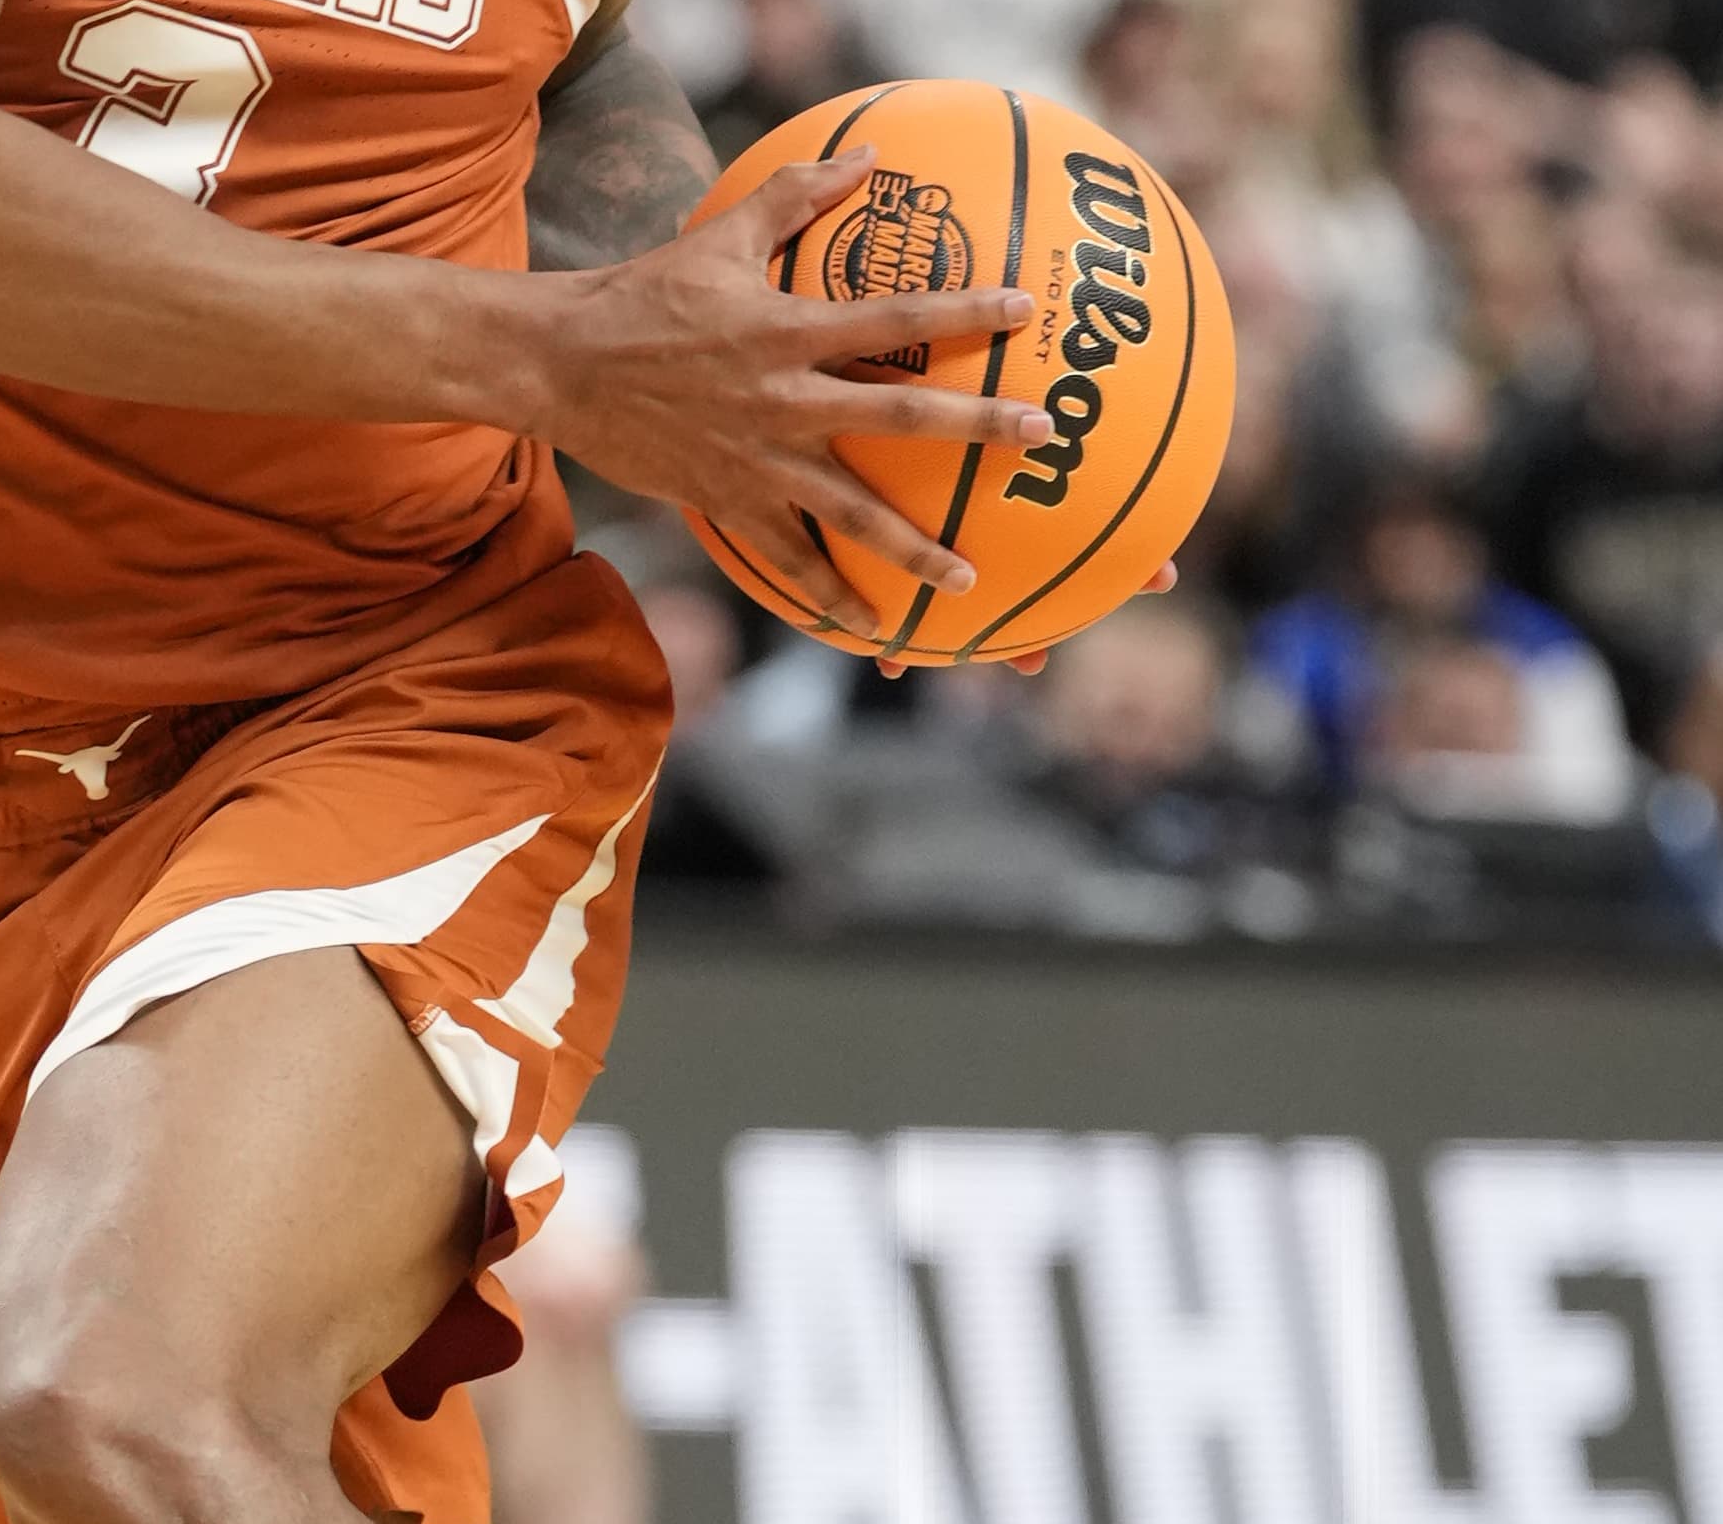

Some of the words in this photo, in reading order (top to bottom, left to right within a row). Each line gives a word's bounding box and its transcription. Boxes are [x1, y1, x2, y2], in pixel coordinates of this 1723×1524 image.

[898, 209, 942, 292] MARC
[1046, 249, 1065, 301] EVO
[1002, 150, 1153, 509] Wilson
[1035, 309, 1058, 364] NXT
